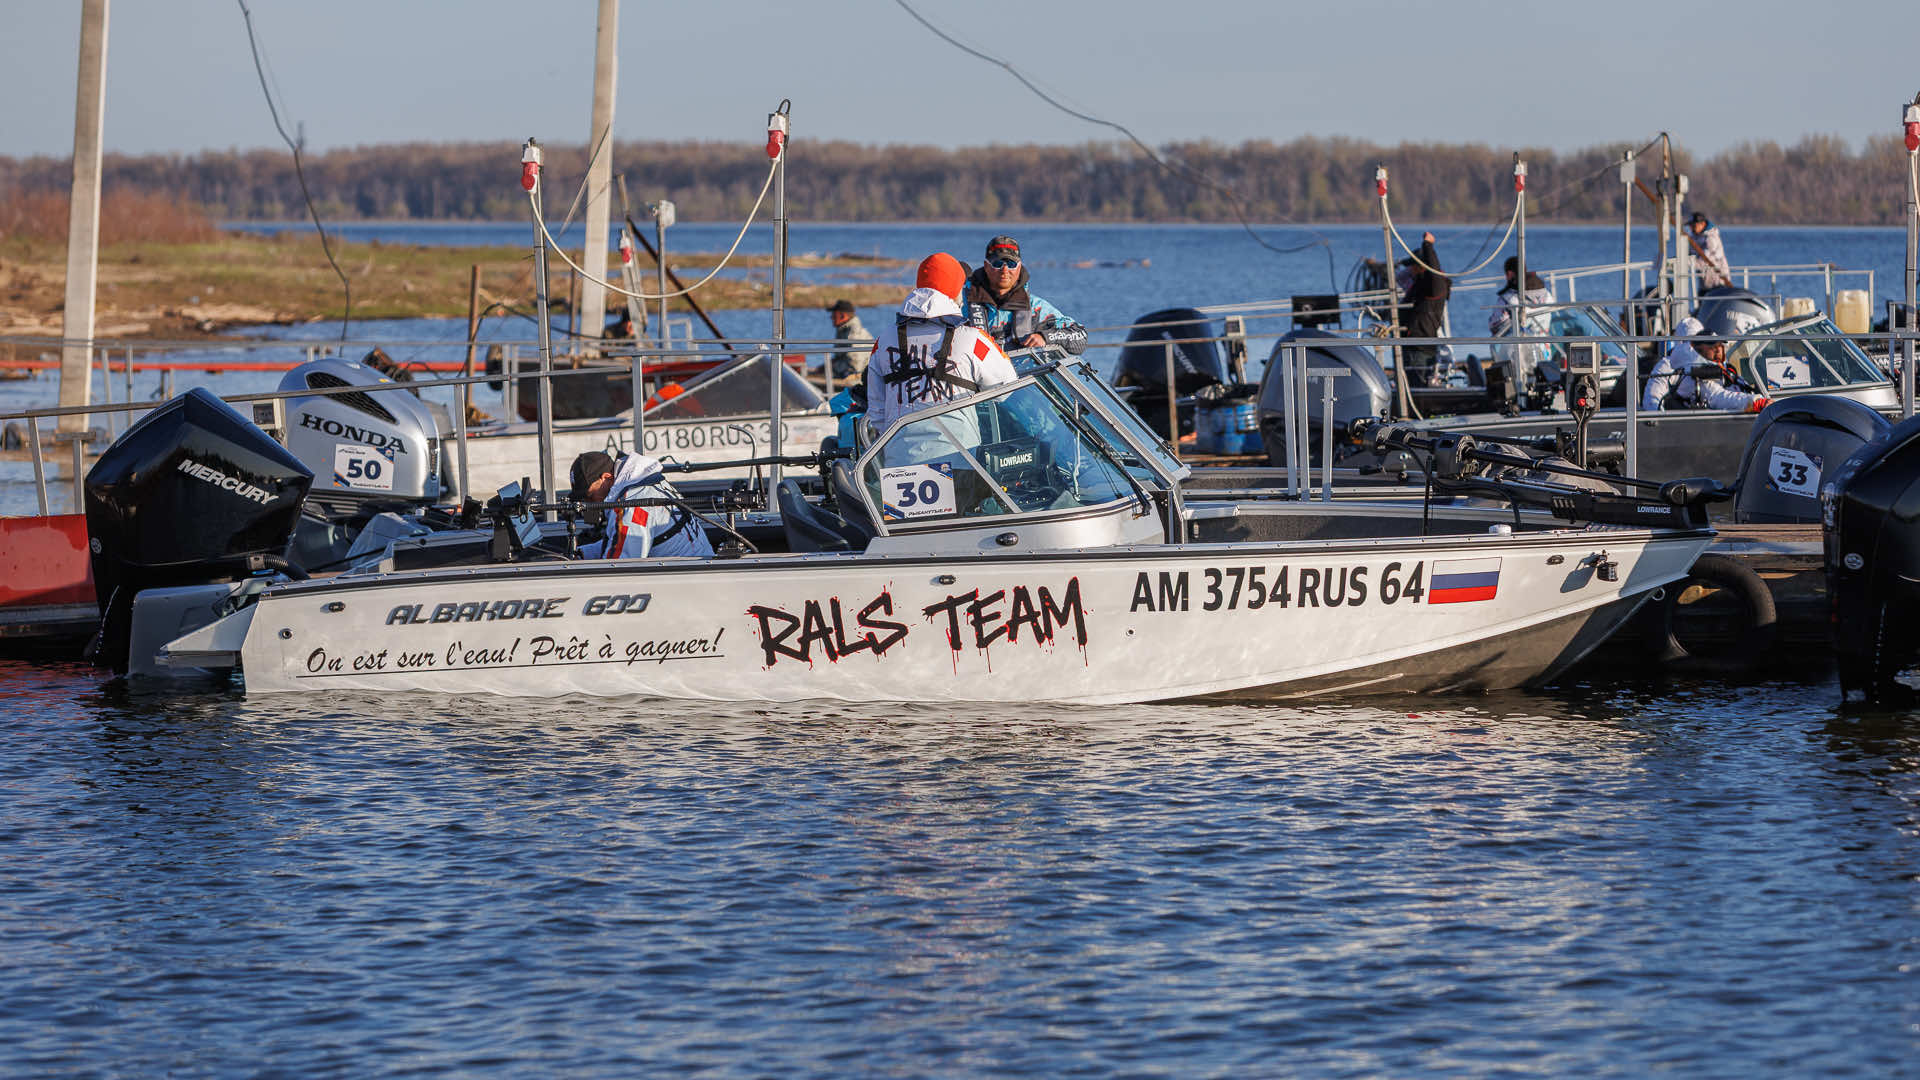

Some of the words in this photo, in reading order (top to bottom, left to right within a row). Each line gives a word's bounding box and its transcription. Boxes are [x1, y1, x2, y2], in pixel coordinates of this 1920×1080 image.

[1782, 366, 1796, 380] 4
[300, 412, 408, 454] HONDA
[347, 458, 381, 480] 50
[1000, 453, 1033, 467] LOWRANCE
[1777, 461, 1809, 486] 33
[177, 459, 279, 505] MERCURY
[896, 479, 940, 508] 30
[1637, 505, 1672, 514] LOWRANCE
[1129, 571, 1189, 612] AM
[1203, 565, 1291, 612] 3754
[1298, 566, 1368, 608] RUS
[1379, 561, 1424, 605] 64
[385, 597, 571, 625] ALBAKORE
[582, 593, 652, 616] 600
[745, 588, 910, 669] RALS
[921, 577, 1091, 668] TEAM
[307, 647, 343, 673] On
[353, 649, 388, 671] est
[397, 651, 435, 669] sur
[445, 637, 520, 666] l'eau!
[530, 635, 589, 665] Prêt
[598, 634, 615, 659] à
[624, 627, 725, 666] gagner!
